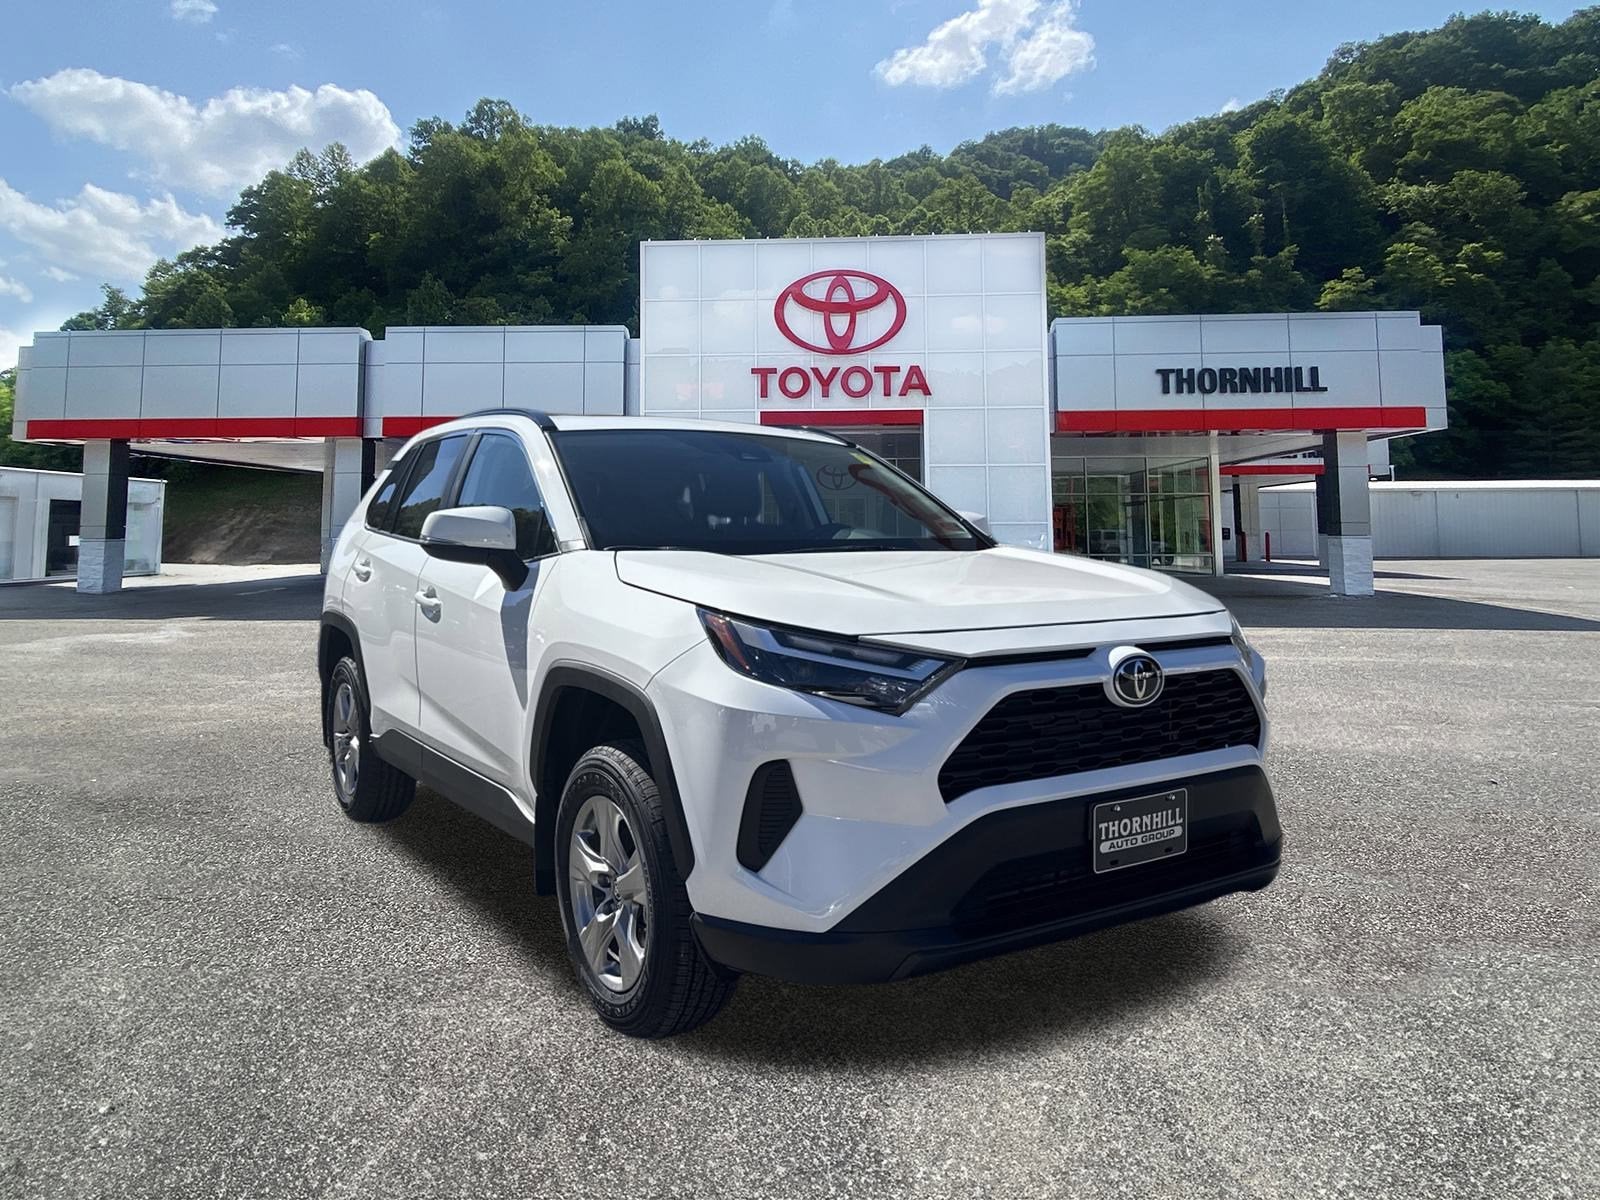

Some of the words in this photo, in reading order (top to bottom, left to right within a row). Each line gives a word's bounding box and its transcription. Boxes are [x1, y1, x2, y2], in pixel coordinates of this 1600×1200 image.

[751, 365, 932, 399] TOYOTA
[1156, 366, 1328, 394] THORNHILL
[1099, 807, 1184, 840] THORNHILL
[1108, 837, 1138, 850] AUTO
[1141, 829, 1176, 844] GROUP
